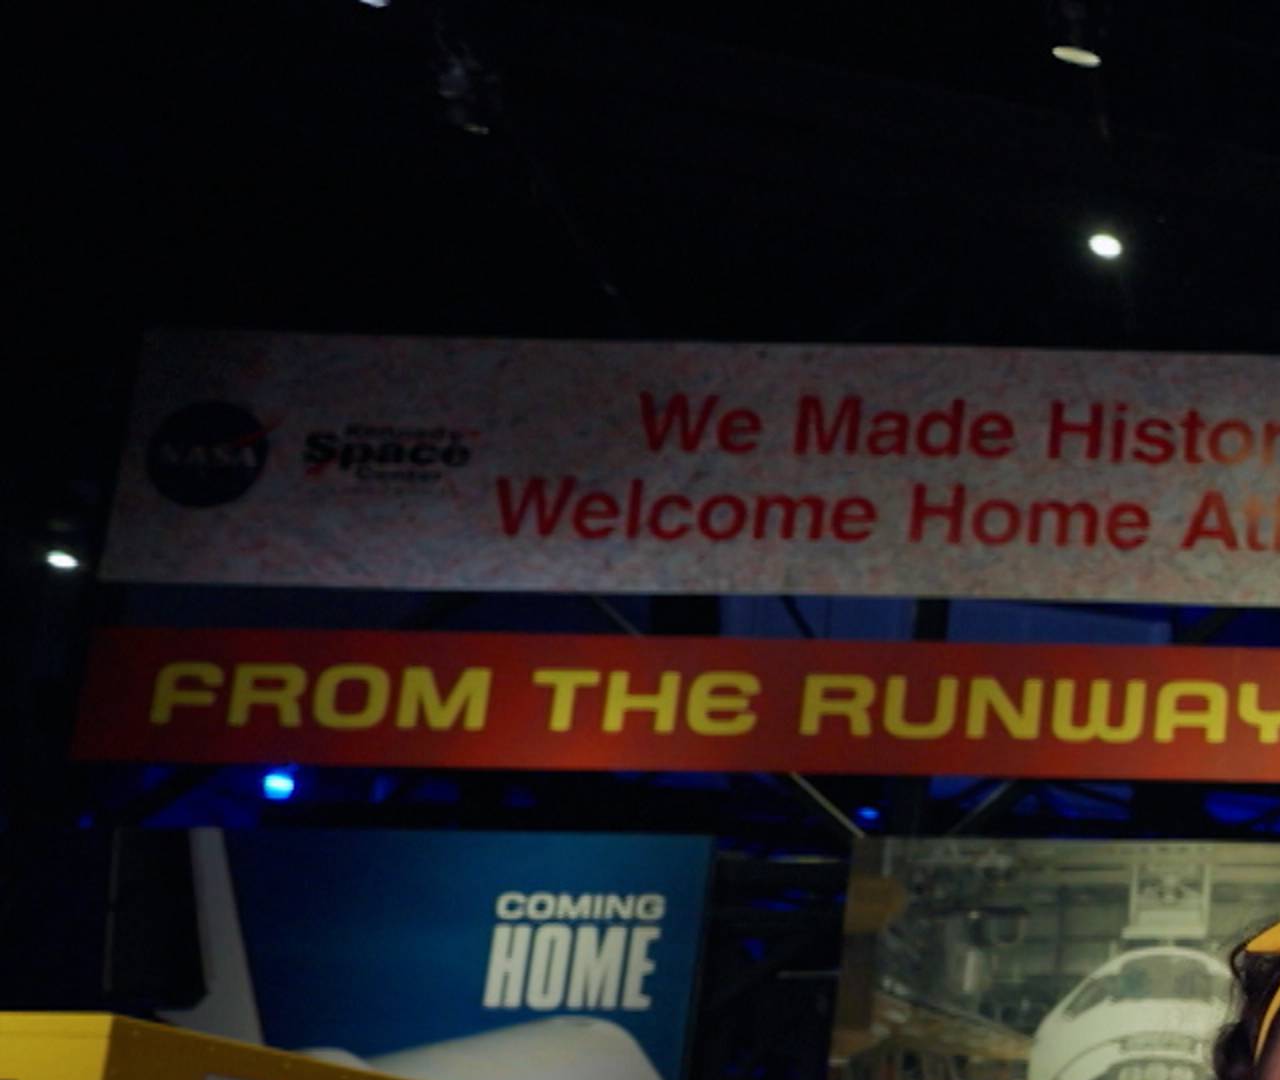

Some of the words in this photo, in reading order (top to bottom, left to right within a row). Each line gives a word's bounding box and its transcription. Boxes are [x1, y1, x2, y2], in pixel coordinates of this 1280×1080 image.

[304, 431, 471, 469] Space
[640, 391, 761, 455] We
[792, 396, 1015, 460] Made
[497, 476, 880, 543] Welcome
[907, 483, 1152, 549] Home
[151, 662, 491, 731] FROM
[532, 669, 760, 736] THE
[495, 890, 667, 921] COMING
[482, 922, 662, 1012] HOME
